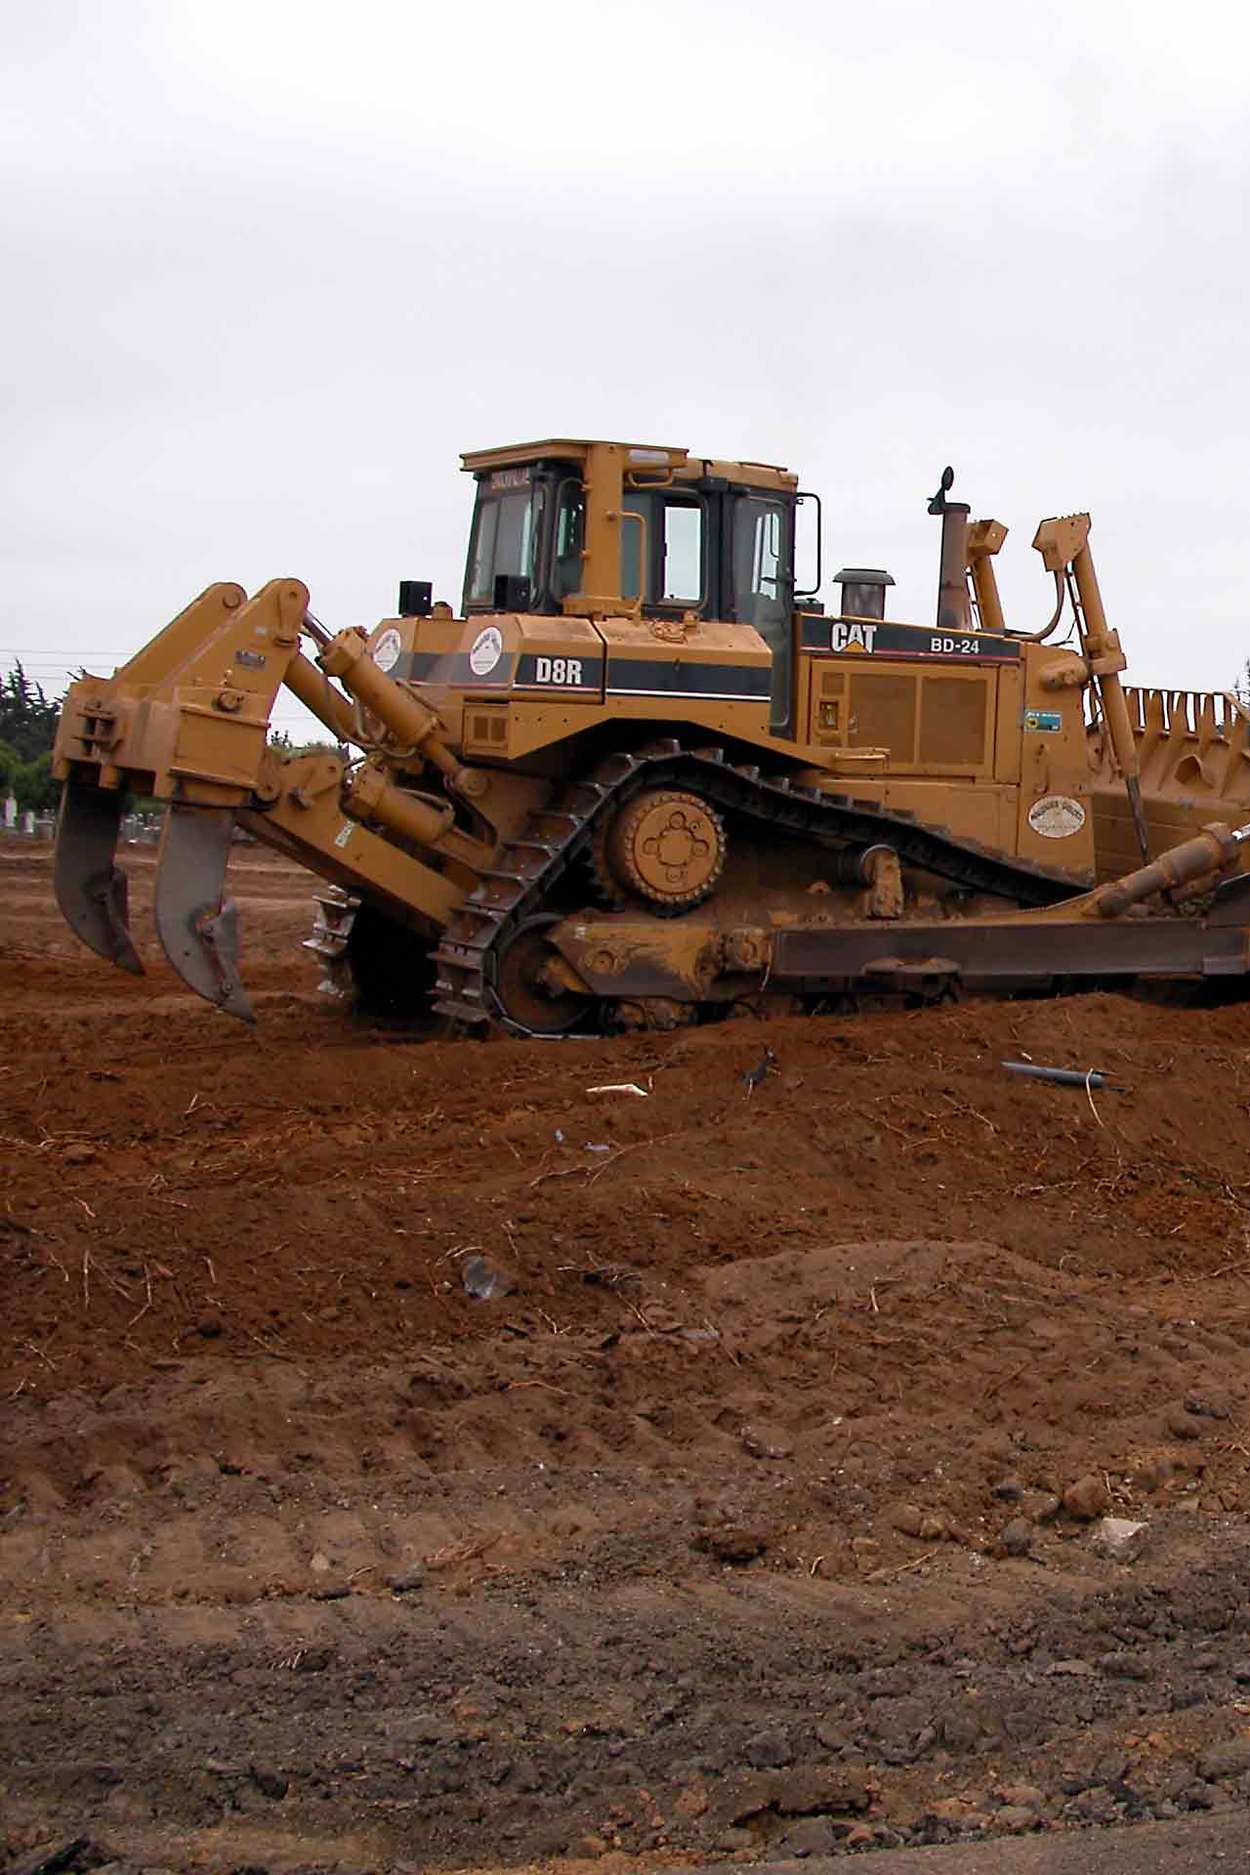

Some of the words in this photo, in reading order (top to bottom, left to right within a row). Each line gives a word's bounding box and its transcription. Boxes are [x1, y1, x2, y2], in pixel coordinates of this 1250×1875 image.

[832, 623, 877, 654] CAT
[931, 637, 980, 654] BD-24
[536, 657, 582, 685] D8R
